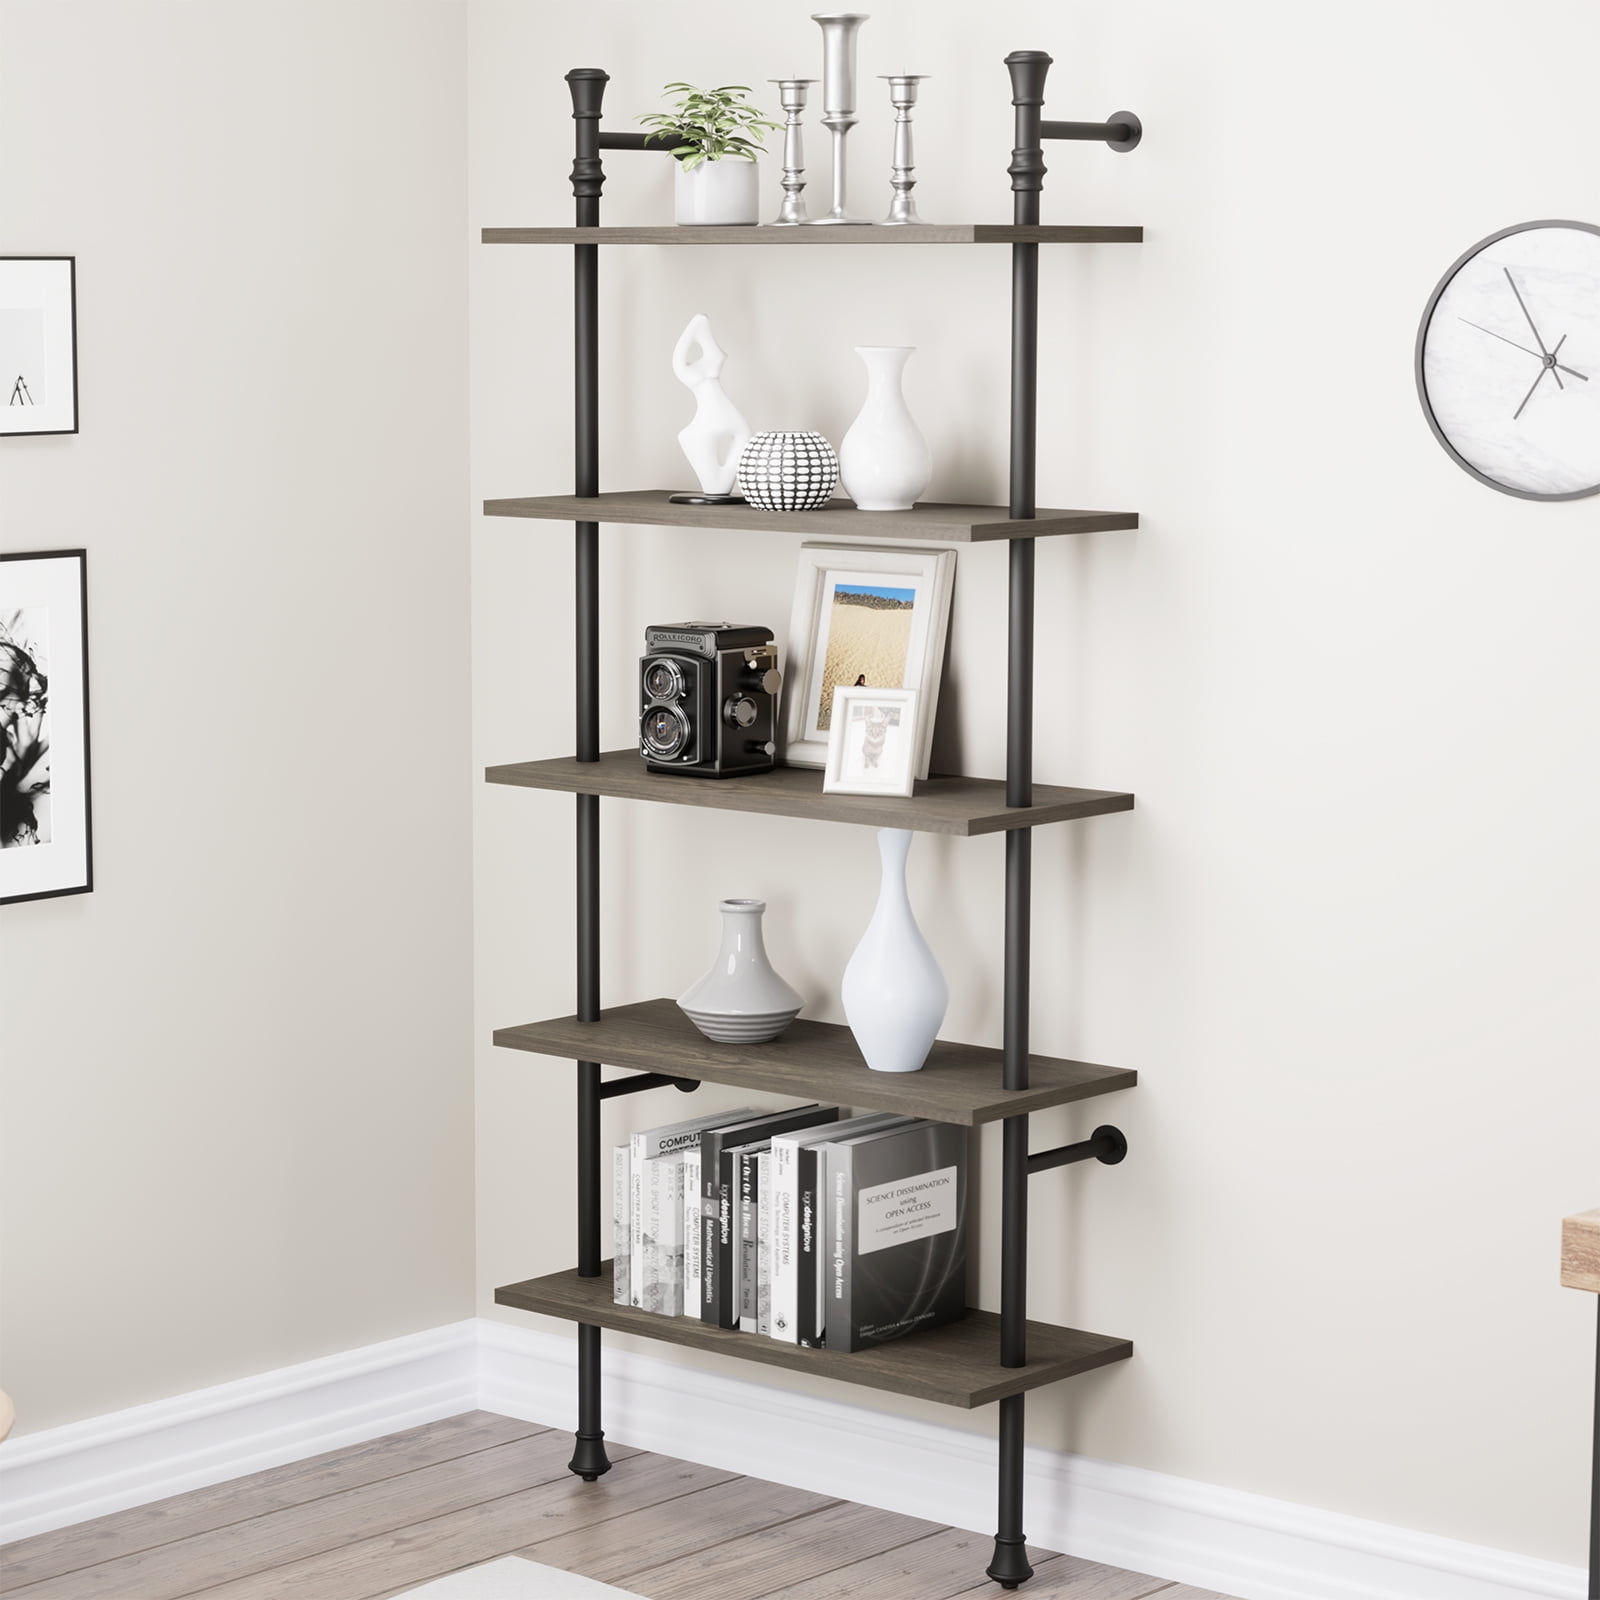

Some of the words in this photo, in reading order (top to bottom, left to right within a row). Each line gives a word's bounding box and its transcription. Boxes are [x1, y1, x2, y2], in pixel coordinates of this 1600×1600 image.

[653, 633, 703, 643] ROLLEICORD
[835, 1172, 845, 1196] Science
[866, 1191, 894, 1205] SCIENCE
[896, 1177, 950, 1197] DISSEMINATION
[781, 1192, 790, 1232] COMPUTER
[885, 1208, 905, 1220] OPEN
[906, 1201, 931, 1213] ACCESS
[900, 1196, 917, 1206] using
[692, 1207, 700, 1246] COMPUTER
[835, 1197, 846, 1241] Dissemination
[706, 1219, 714, 1267] Mathematical
[781, 1233, 790, 1265] SYSTEMS
[833, 1241, 845, 1258] using
[692, 1247, 700, 1279] SYSTEMS
[833, 1259, 845, 1277] Open
[704, 1267, 714, 1303] Linguistics
[835, 1278, 844, 1299] Access
